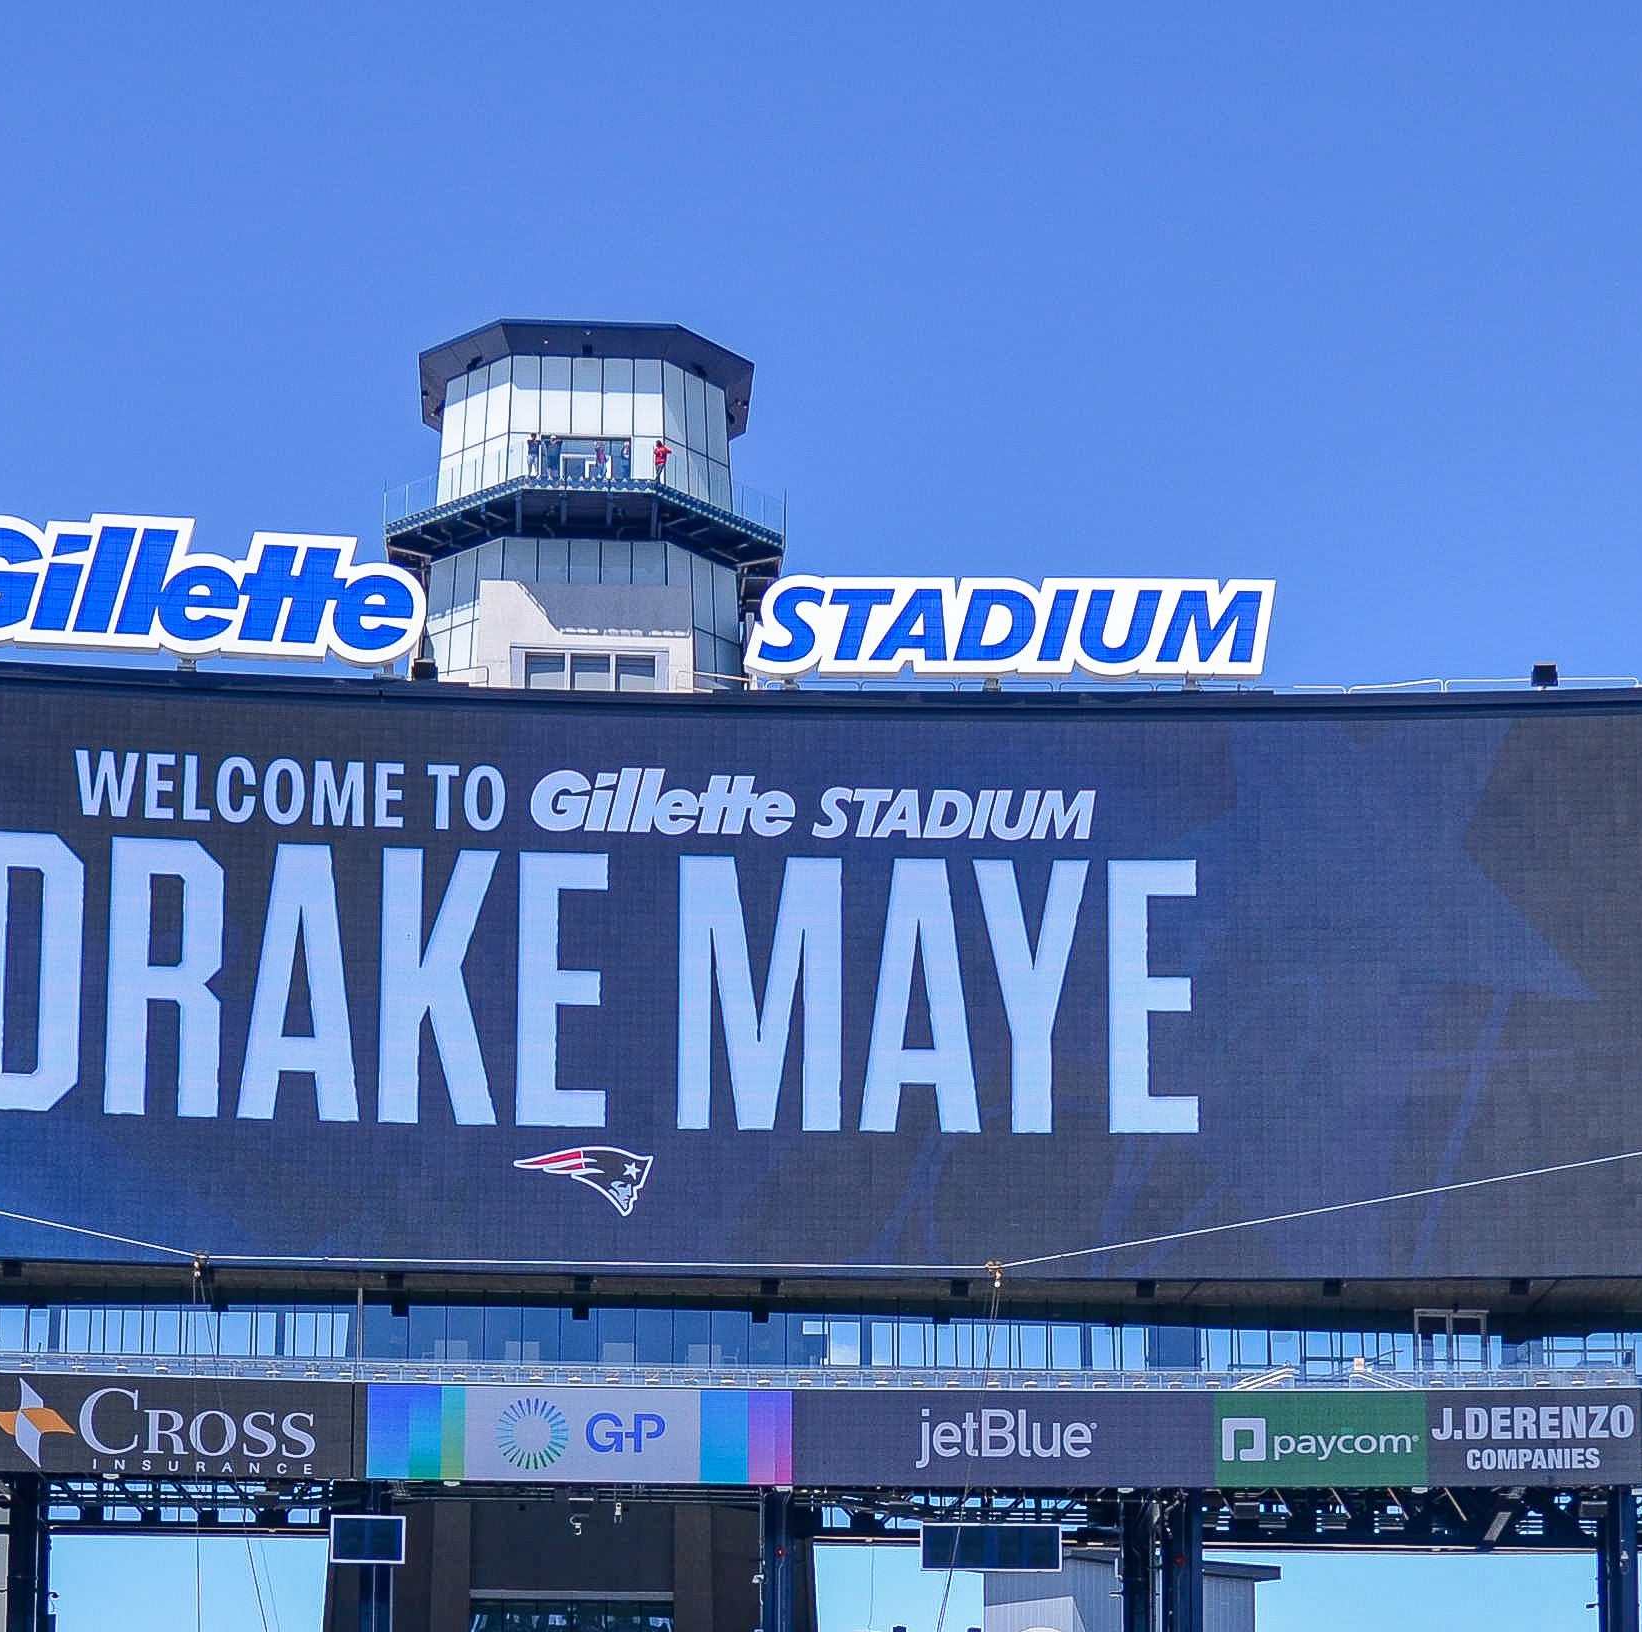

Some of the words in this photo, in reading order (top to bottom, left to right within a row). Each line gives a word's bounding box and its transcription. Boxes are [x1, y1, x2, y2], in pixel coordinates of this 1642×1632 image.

[758, 585, 1263, 664] STADIUM
[74, 748, 405, 829] WELCOME
[427, 763, 506, 832] TO
[530, 767, 797, 838] Gillette
[812, 787, 1097, 841] STADIUM
[676, 854, 1201, 1135] MAYE
[78, 1387, 317, 1460] CROSS
[584, 1411, 666, 1454] GP
[914, 1407, 1093, 1469] jetBlue
[1272, 1430, 1412, 1462] paycom
[1430, 1404, 1636, 1443] J.DERENZO
[91, 1457, 314, 1475] INSURANCE
[1464, 1446, 1601, 1472] COMPANIES
